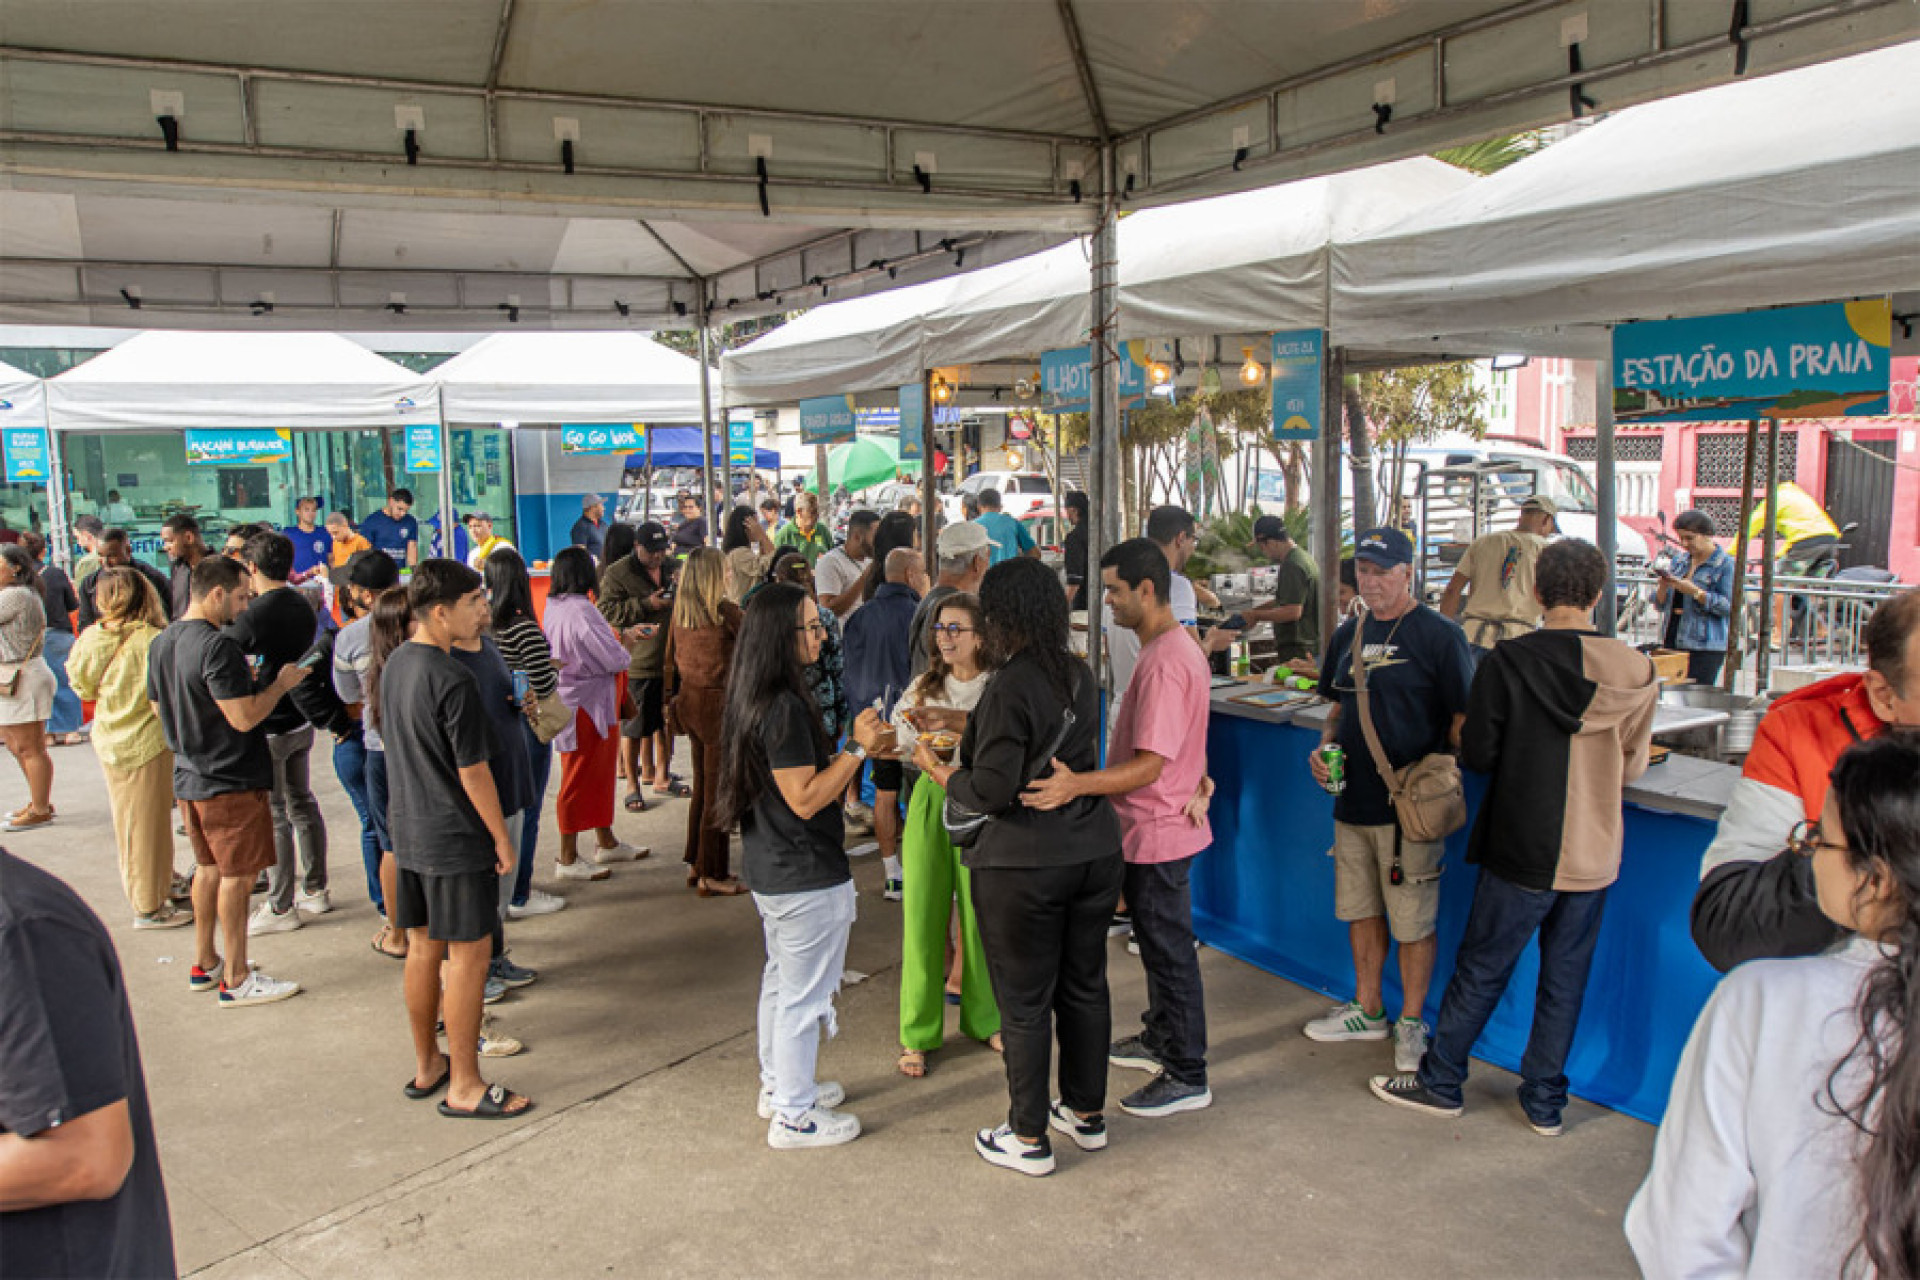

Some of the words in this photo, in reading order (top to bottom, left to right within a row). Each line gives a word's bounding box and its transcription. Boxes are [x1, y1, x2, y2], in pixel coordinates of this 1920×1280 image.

[1621, 343, 1735, 389] ESTAÇÃO
[1744, 346, 1779, 380] DA
[1789, 339, 1873, 379] PRAIA
